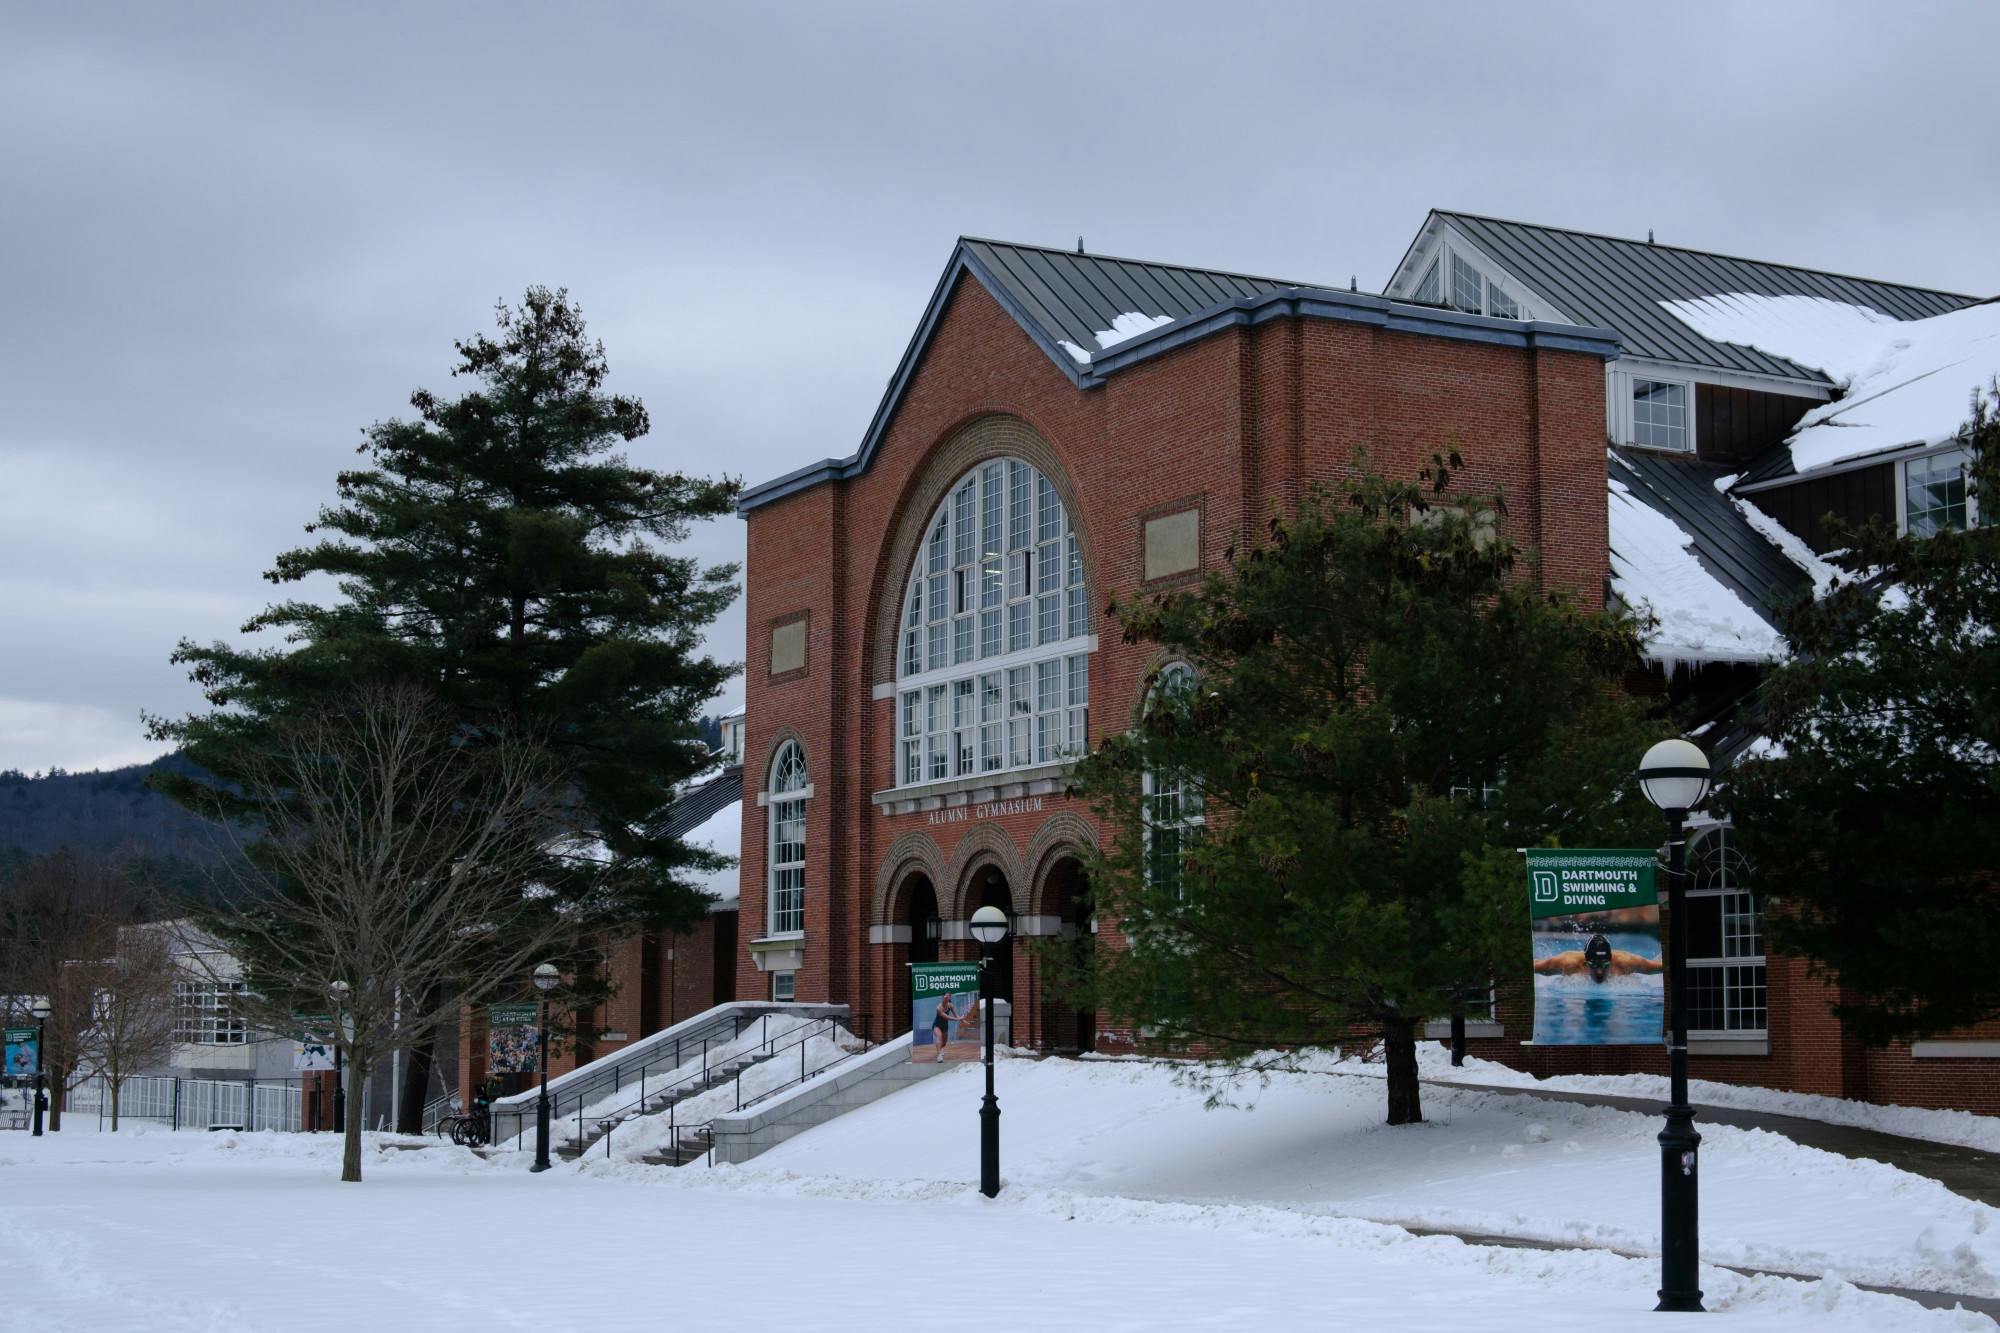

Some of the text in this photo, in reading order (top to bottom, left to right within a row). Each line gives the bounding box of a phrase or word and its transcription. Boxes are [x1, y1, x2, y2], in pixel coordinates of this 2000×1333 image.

[928, 798, 1042, 825] ALUMNI GYMNASIUM
[1561, 870, 1638, 881] DARTMOUTH
[1533, 871, 1558, 902] D
[1562, 882, 1637, 893] SWIMMING &
[1563, 895, 1606, 905] DIVING
[915, 974, 928, 991] D
[929, 982, 960, 990] SQUASH
